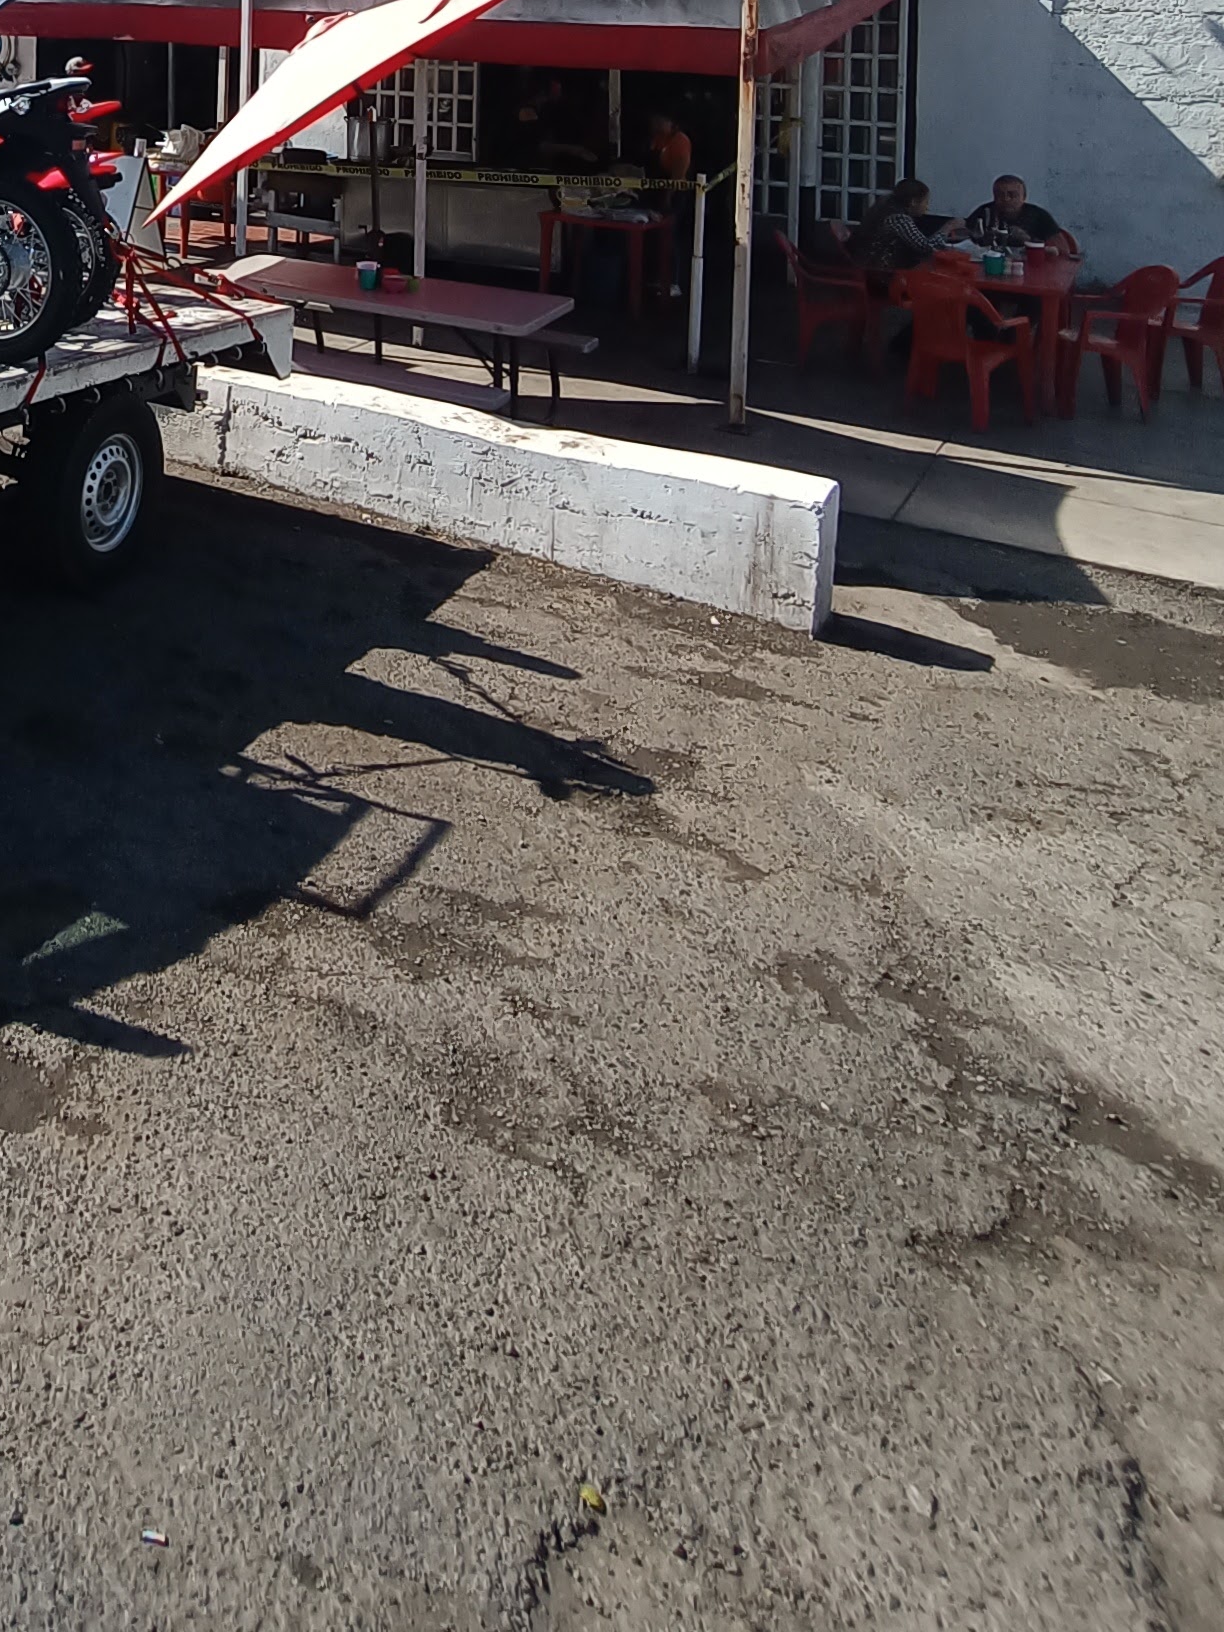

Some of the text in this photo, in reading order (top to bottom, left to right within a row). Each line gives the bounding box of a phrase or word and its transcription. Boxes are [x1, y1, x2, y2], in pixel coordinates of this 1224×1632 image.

[336, 166, 389, 176] PROHIBDO
[404, 169, 462, 180] PRHIBIDO
[477, 172, 540, 184] PROHIBIDO
[556, 175, 622, 187] PROHIBIDO
